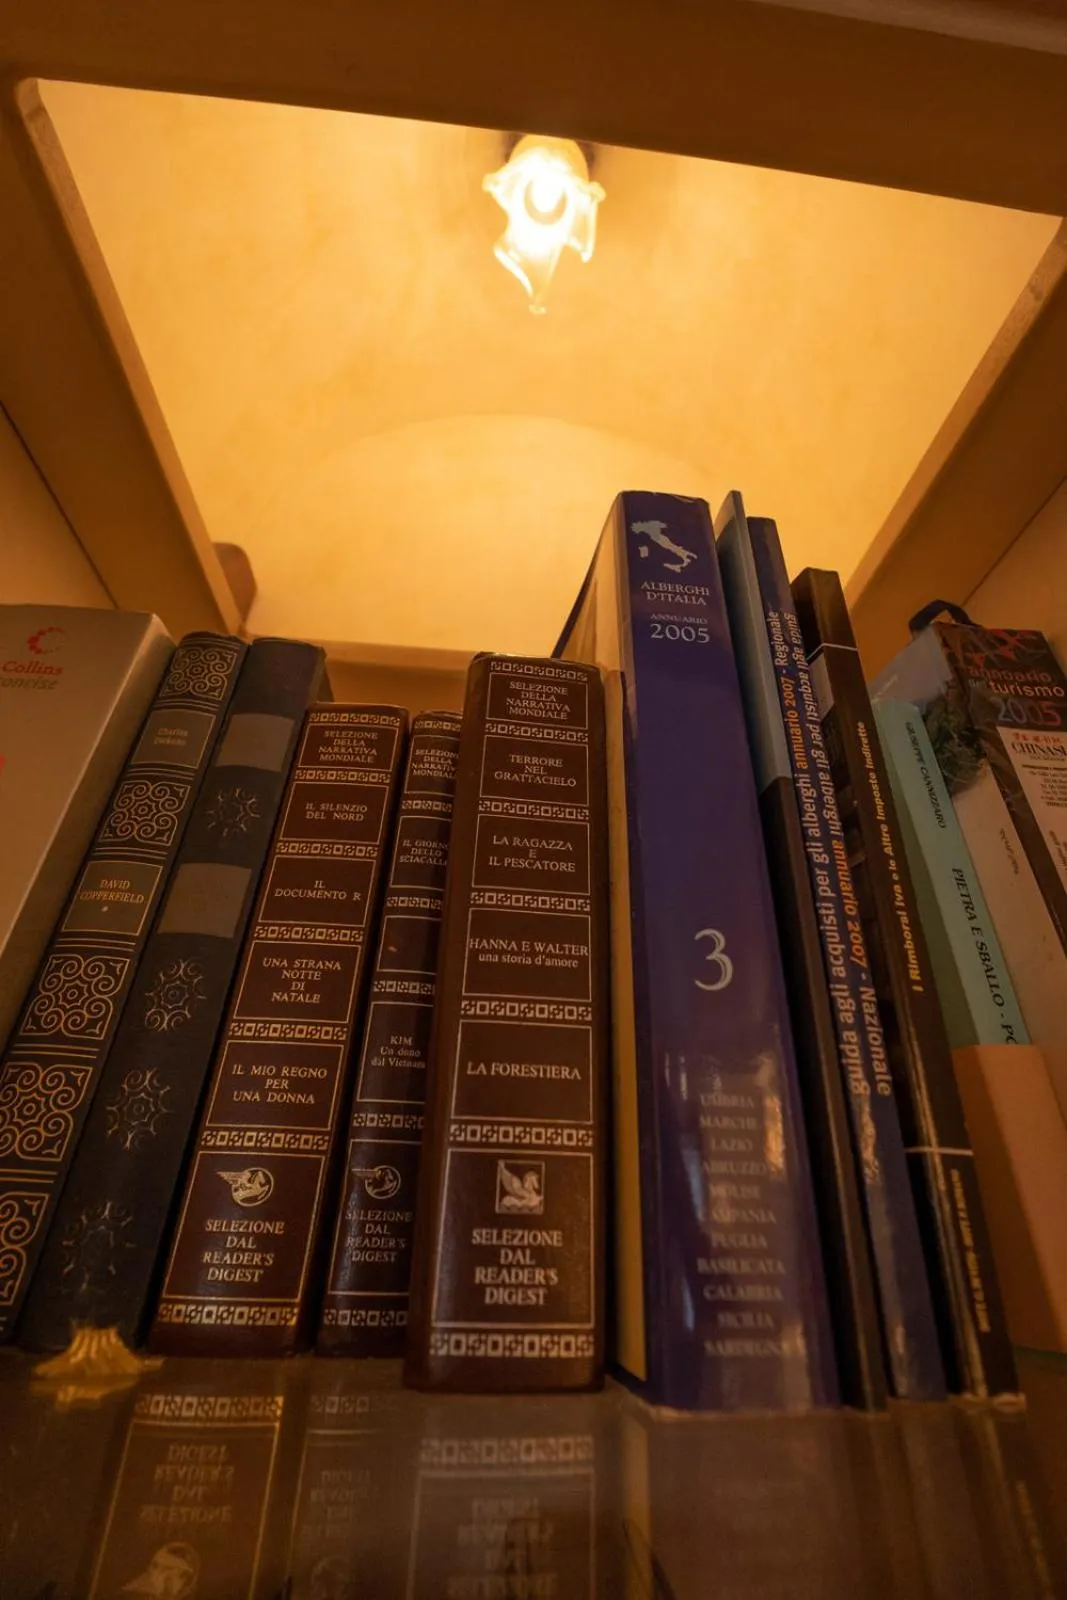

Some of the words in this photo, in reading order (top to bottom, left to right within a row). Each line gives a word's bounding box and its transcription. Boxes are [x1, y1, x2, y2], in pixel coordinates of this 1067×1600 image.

[641, 581, 710, 596] ALBERGHI
[646, 592, 706, 606] D'ITALIA
[651, 613, 708, 624] ANNUARIO
[651, 623, 710, 644] 2005
[768, 611, 788, 667] Regionale
[2, 660, 64, 676] Collins
[969, 666, 1052, 683] annuario
[509, 680, 568, 695] SELEZIONE
[781, 677, 797, 707] 2007
[989, 680, 1065, 698] turismo
[521, 691, 557, 702] DELLA
[798, 671, 820, 721] acquisti
[506, 699, 570, 713] NARRATIVA
[509, 706, 568, 720] MONDIALE
[997, 698, 1062, 726] 2005
[324, 730, 378, 740] SELEZIONE
[784, 710, 808, 769] annuario
[807, 723, 825, 746] per
[333, 738, 365, 747] DELLA
[857, 721, 876, 769] Indirette
[318, 746, 377, 756] NARRATIVA
[811, 748, 830, 769] gli
[319, 754, 375, 764] MONDIALE
[423, 756, 452, 765] DELLA
[509, 754, 563, 768] TERRORE
[412, 763, 456, 772] NARRATIV
[412, 769, 456, 779] MONDIAL
[525, 765, 547, 775] NEL
[494, 771, 576, 787] GRATTACIELO
[868, 772, 886, 821] Imposte
[305, 802, 316, 811] IL
[320, 803, 368, 813] SILENZIO
[794, 773, 821, 837] alberghi
[818, 772, 845, 838] alberghi
[306, 811, 326, 820] DEL
[332, 812, 365, 822] NORD
[402, 839, 411, 847] IL
[493, 835, 509, 846] LA
[513, 836, 573, 851] RAGAZZA
[879, 821, 895, 857] Altre
[410, 847, 442, 857] DELLO
[528, 849, 536, 858] E
[806, 842, 829, 864] gli
[489, 856, 501, 866] IL
[504, 857, 575, 872] PESCATORE
[889, 858, 898, 872] le
[100, 878, 130, 890] DAVID
[314, 880, 325, 889] IL
[815, 868, 836, 898] per
[832, 839, 858, 916] annuario
[80, 890, 145, 904] COPPERFIELD
[274, 888, 347, 900] DOCUMENTO
[352, 892, 361, 901] R
[893, 884, 906, 910] Iva
[952, 867, 977, 923] PIETRA
[971, 925, 984, 937] E
[469, 938, 517, 951] HANNA
[522, 941, 531, 952] E
[534, 942, 589, 956] WALTER
[816, 902, 846, 977] acquisti
[847, 920, 869, 969] 2007
[897, 910, 921, 982] Rimborsi
[262, 957, 288, 968] UNA
[293, 959, 342, 970] STRANA
[479, 953, 499, 963] una
[501, 953, 532, 965] storia
[534, 955, 578, 968] d'amore
[694, 928, 734, 991] 3
[281, 969, 322, 980] NOTTE
[975, 939, 1005, 1008] SBALLO
[291, 981, 305, 991] DI
[271, 992, 321, 1004] NATALE
[830, 984, 856, 1024] agli
[390, 1035, 412, 1046] KIM
[859, 986, 893, 1097] Nazionale
[371, 1057, 385, 1067] dal
[839, 1030, 871, 1097] guida
[232, 1064, 244, 1075] IL
[250, 1065, 276, 1076] MIO
[281, 1066, 327, 1078] REGNO
[467, 1062, 486, 1075] LA
[491, 1062, 582, 1081] FORESTIERA
[264, 1079, 289, 1089] PER
[233, 1091, 260, 1102] UNA
[267, 1092, 315, 1104] DONNA
[345, 1210, 413, 1223] SELEZIONE
[205, 1219, 285, 1234] SELEZIONE
[364, 1223, 391, 1234] DAL
[225, 1236, 257, 1249] DAL
[346, 1236, 407, 1249] READER'S
[471, 1228, 563, 1246] SELEZIONE
[202, 1252, 275, 1266] READER'S
[351, 1250, 398, 1263] DIGEST
[500, 1248, 536, 1265] DAL
[207, 1268, 264, 1283] DIGEST
[474, 1267, 558, 1285] READER'S
[485, 1287, 548, 1305] DIGEST
